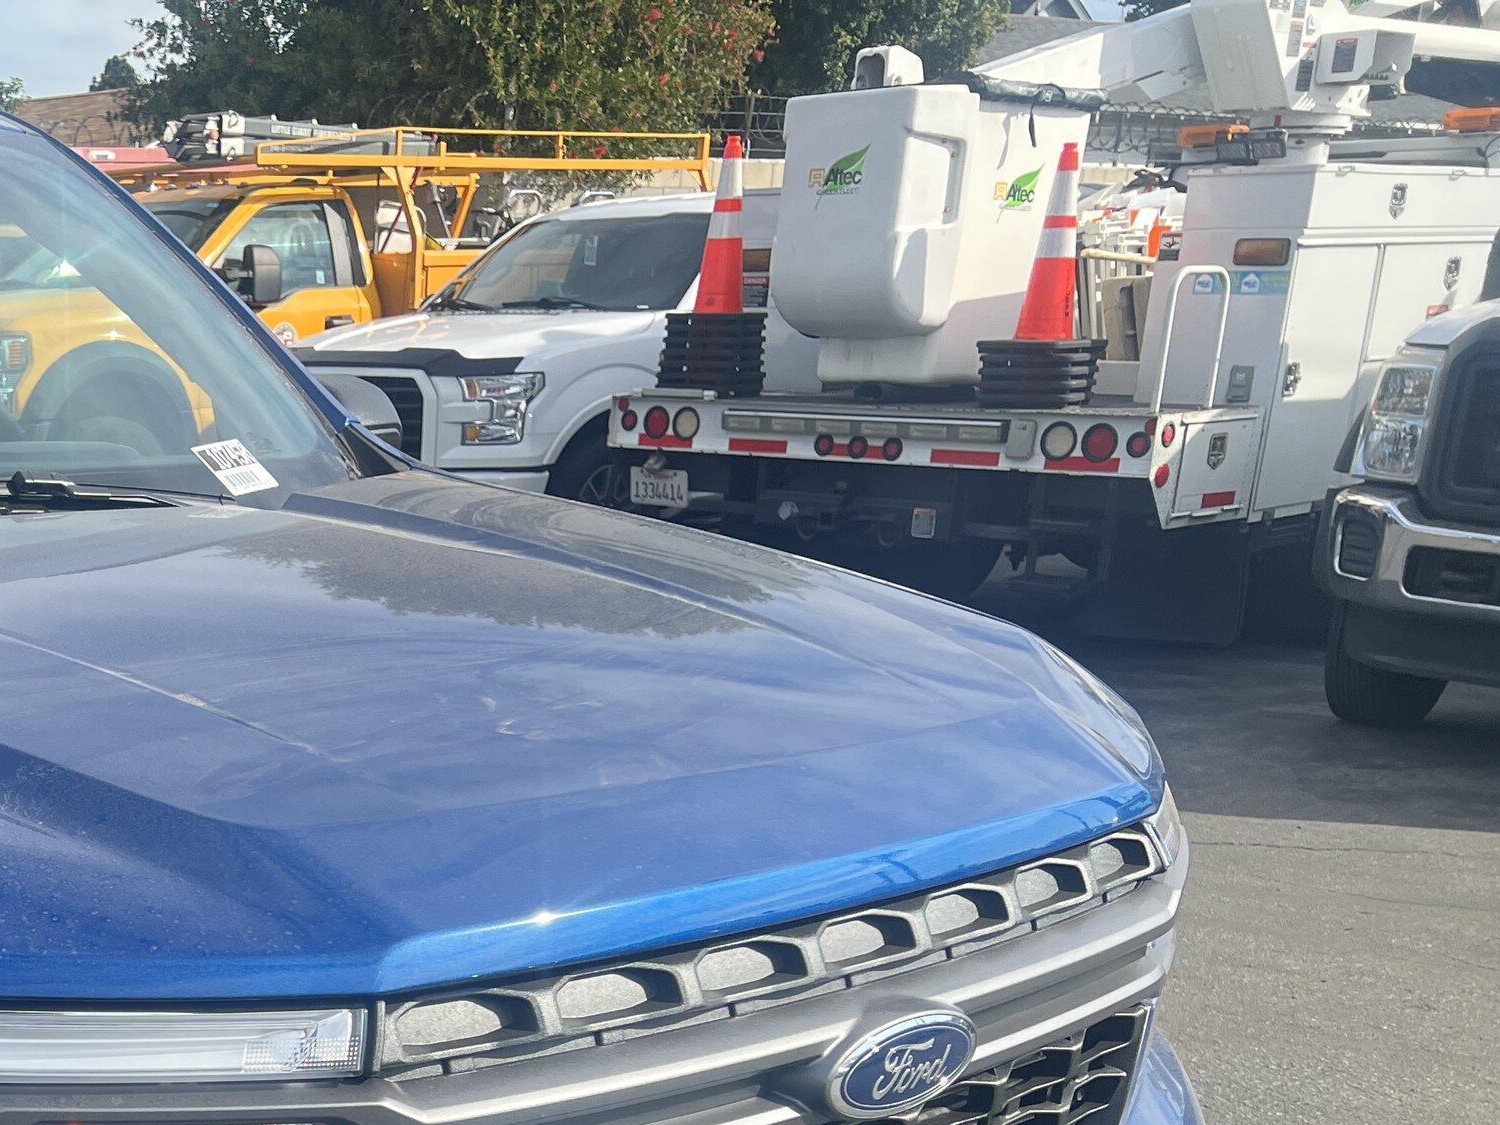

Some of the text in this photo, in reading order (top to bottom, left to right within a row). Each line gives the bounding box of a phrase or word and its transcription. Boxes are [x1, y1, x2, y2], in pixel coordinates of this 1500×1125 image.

[822, 168, 863, 186] Altec
[1005, 183, 1035, 203] Altec
[634, 480, 683, 501] 1334414
[872, 1037, 952, 1100] Ford
